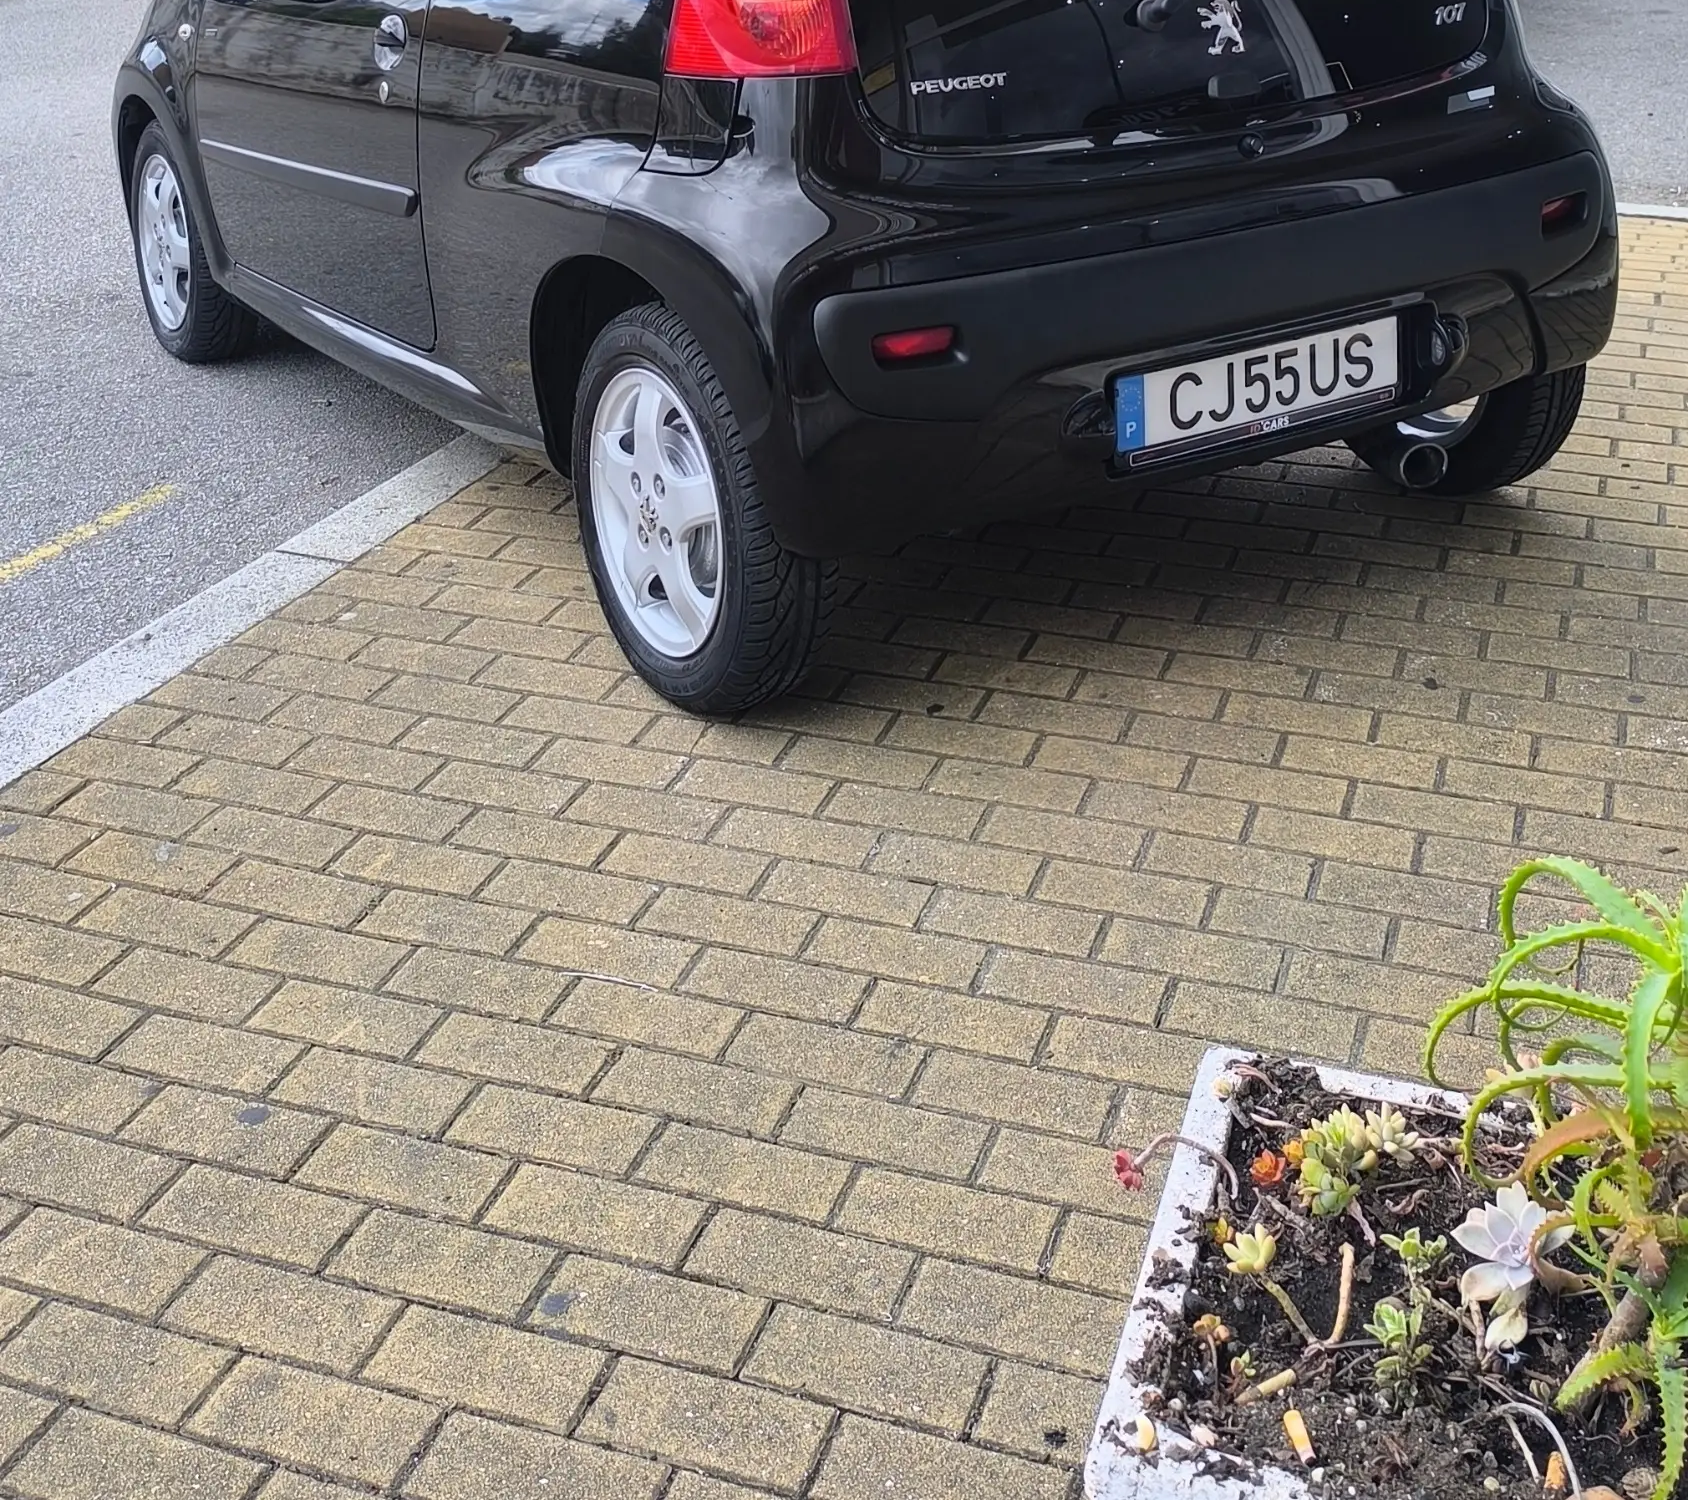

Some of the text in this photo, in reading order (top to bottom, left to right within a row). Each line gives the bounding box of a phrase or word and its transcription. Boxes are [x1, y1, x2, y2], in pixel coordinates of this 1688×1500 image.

[1434, 2, 1467, 26] 107
[910, 71, 1007, 95] PEUGEOT
[1125, 420, 1137, 439] P
